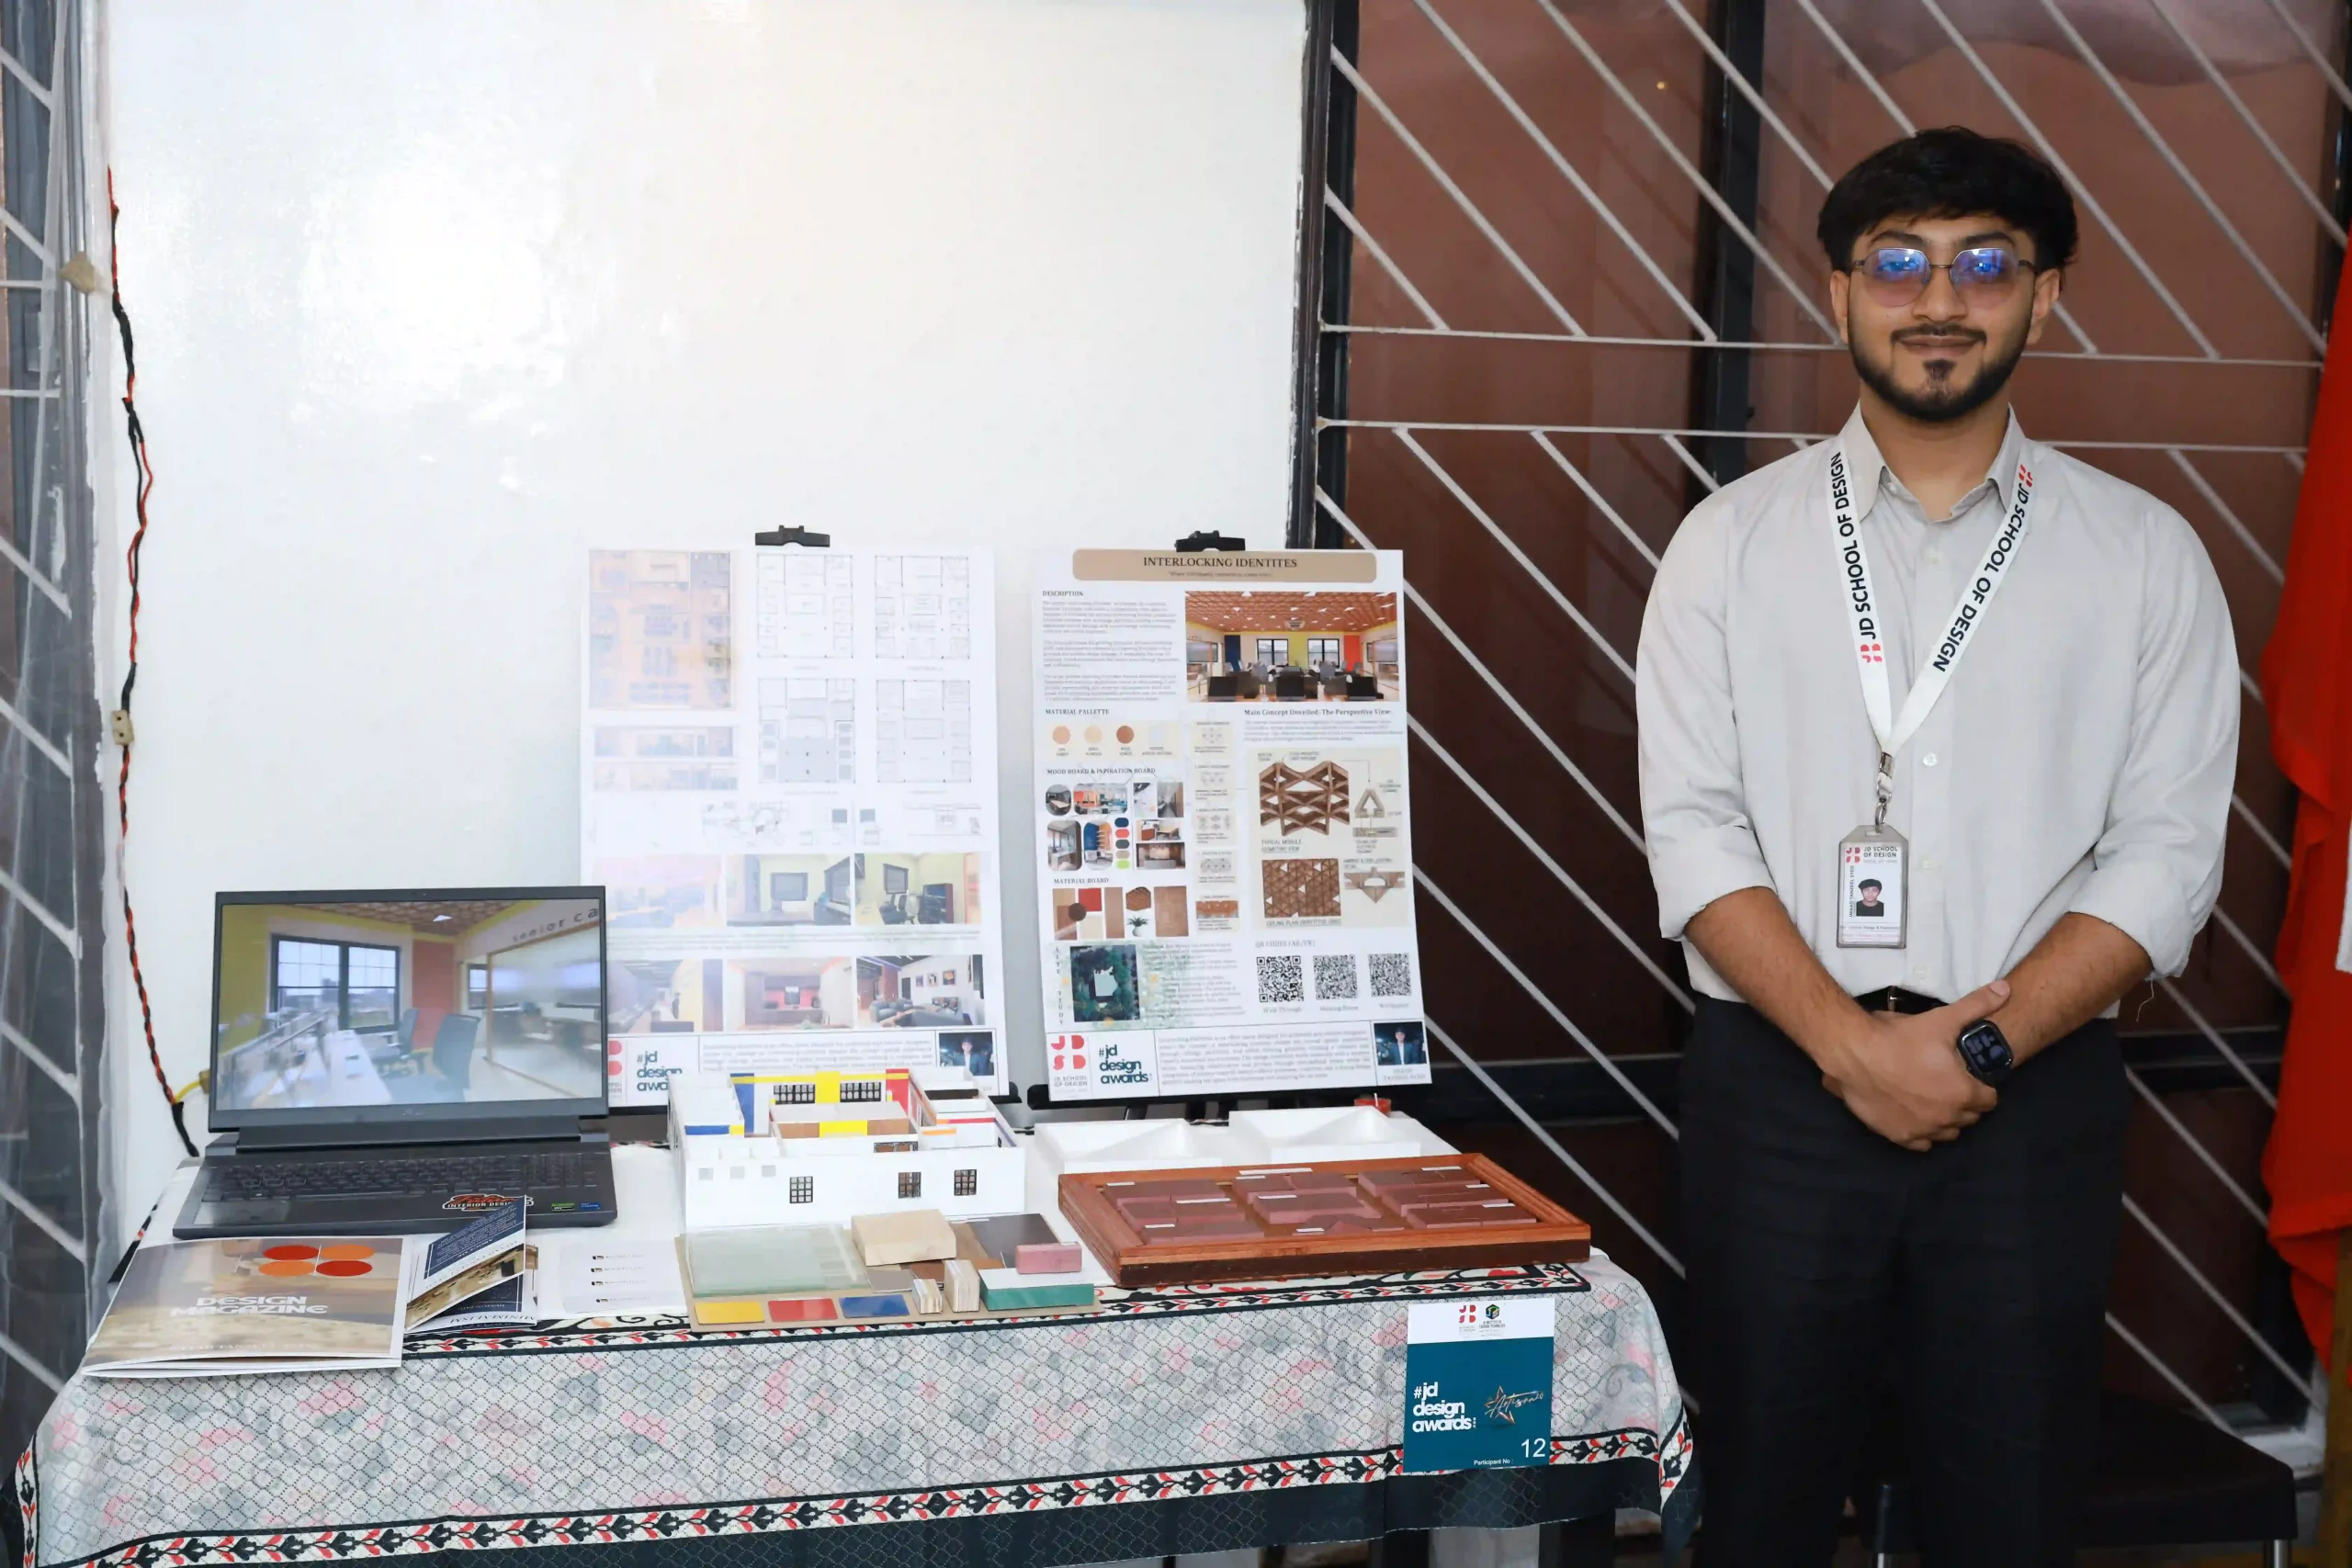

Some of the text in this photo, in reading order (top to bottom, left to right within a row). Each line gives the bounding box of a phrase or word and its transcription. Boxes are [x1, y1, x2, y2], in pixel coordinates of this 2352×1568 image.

[1831, 451, 1876, 640] JD SCHOOL OF DESIGN
[1143, 557, 1297, 568] INTERLOCKING IDENTITES
[1932, 482, 2030, 672] JD SCHOOL OF DESIGN
[1261, 708, 1288, 717] Concept
[1335, 708, 1374, 716] Perspective
[1051, 1035, 1085, 1051] JD
[637, 1051, 658, 1066] #jd
[1099, 1044, 1118, 1060] #jd
[1099, 1059, 1142, 1074] design
[1100, 1072, 1149, 1085] awards
[196, 1296, 308, 1306] DESIGN
[170, 1304, 329, 1317] MAGAZINE
[1413, 1382, 1439, 1400] #jd
[1412, 1400, 1465, 1418] design
[1412, 1415, 1473, 1433] awards
[1521, 1438, 1546, 1459] 12
